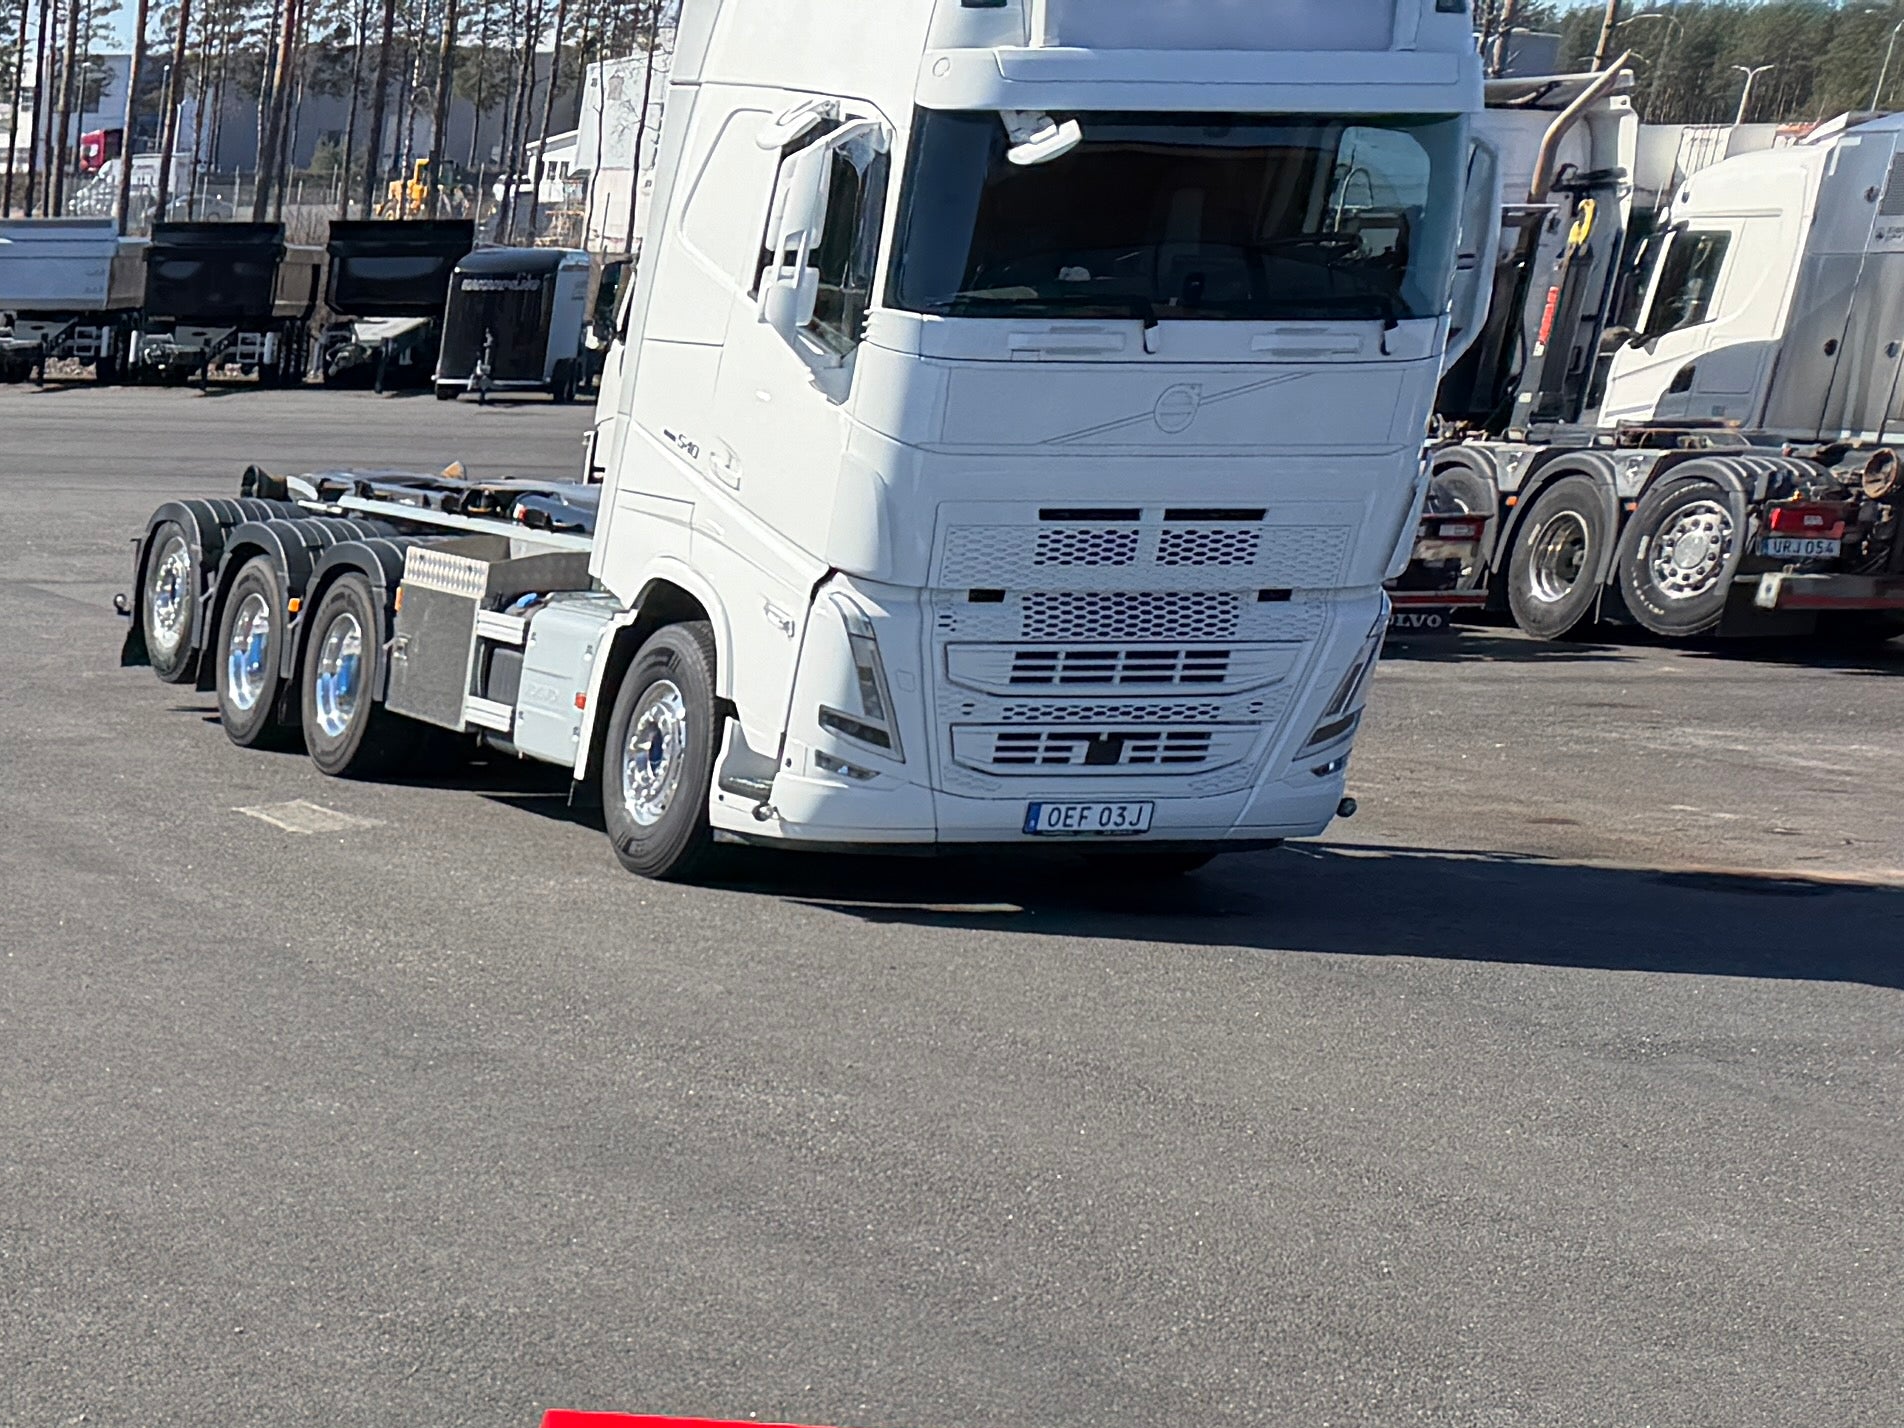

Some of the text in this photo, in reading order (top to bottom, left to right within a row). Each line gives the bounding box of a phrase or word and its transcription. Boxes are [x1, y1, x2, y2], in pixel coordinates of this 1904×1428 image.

[1390, 613, 1442, 628] LVO
[1047, 805, 1143, 828] OEF 03J
